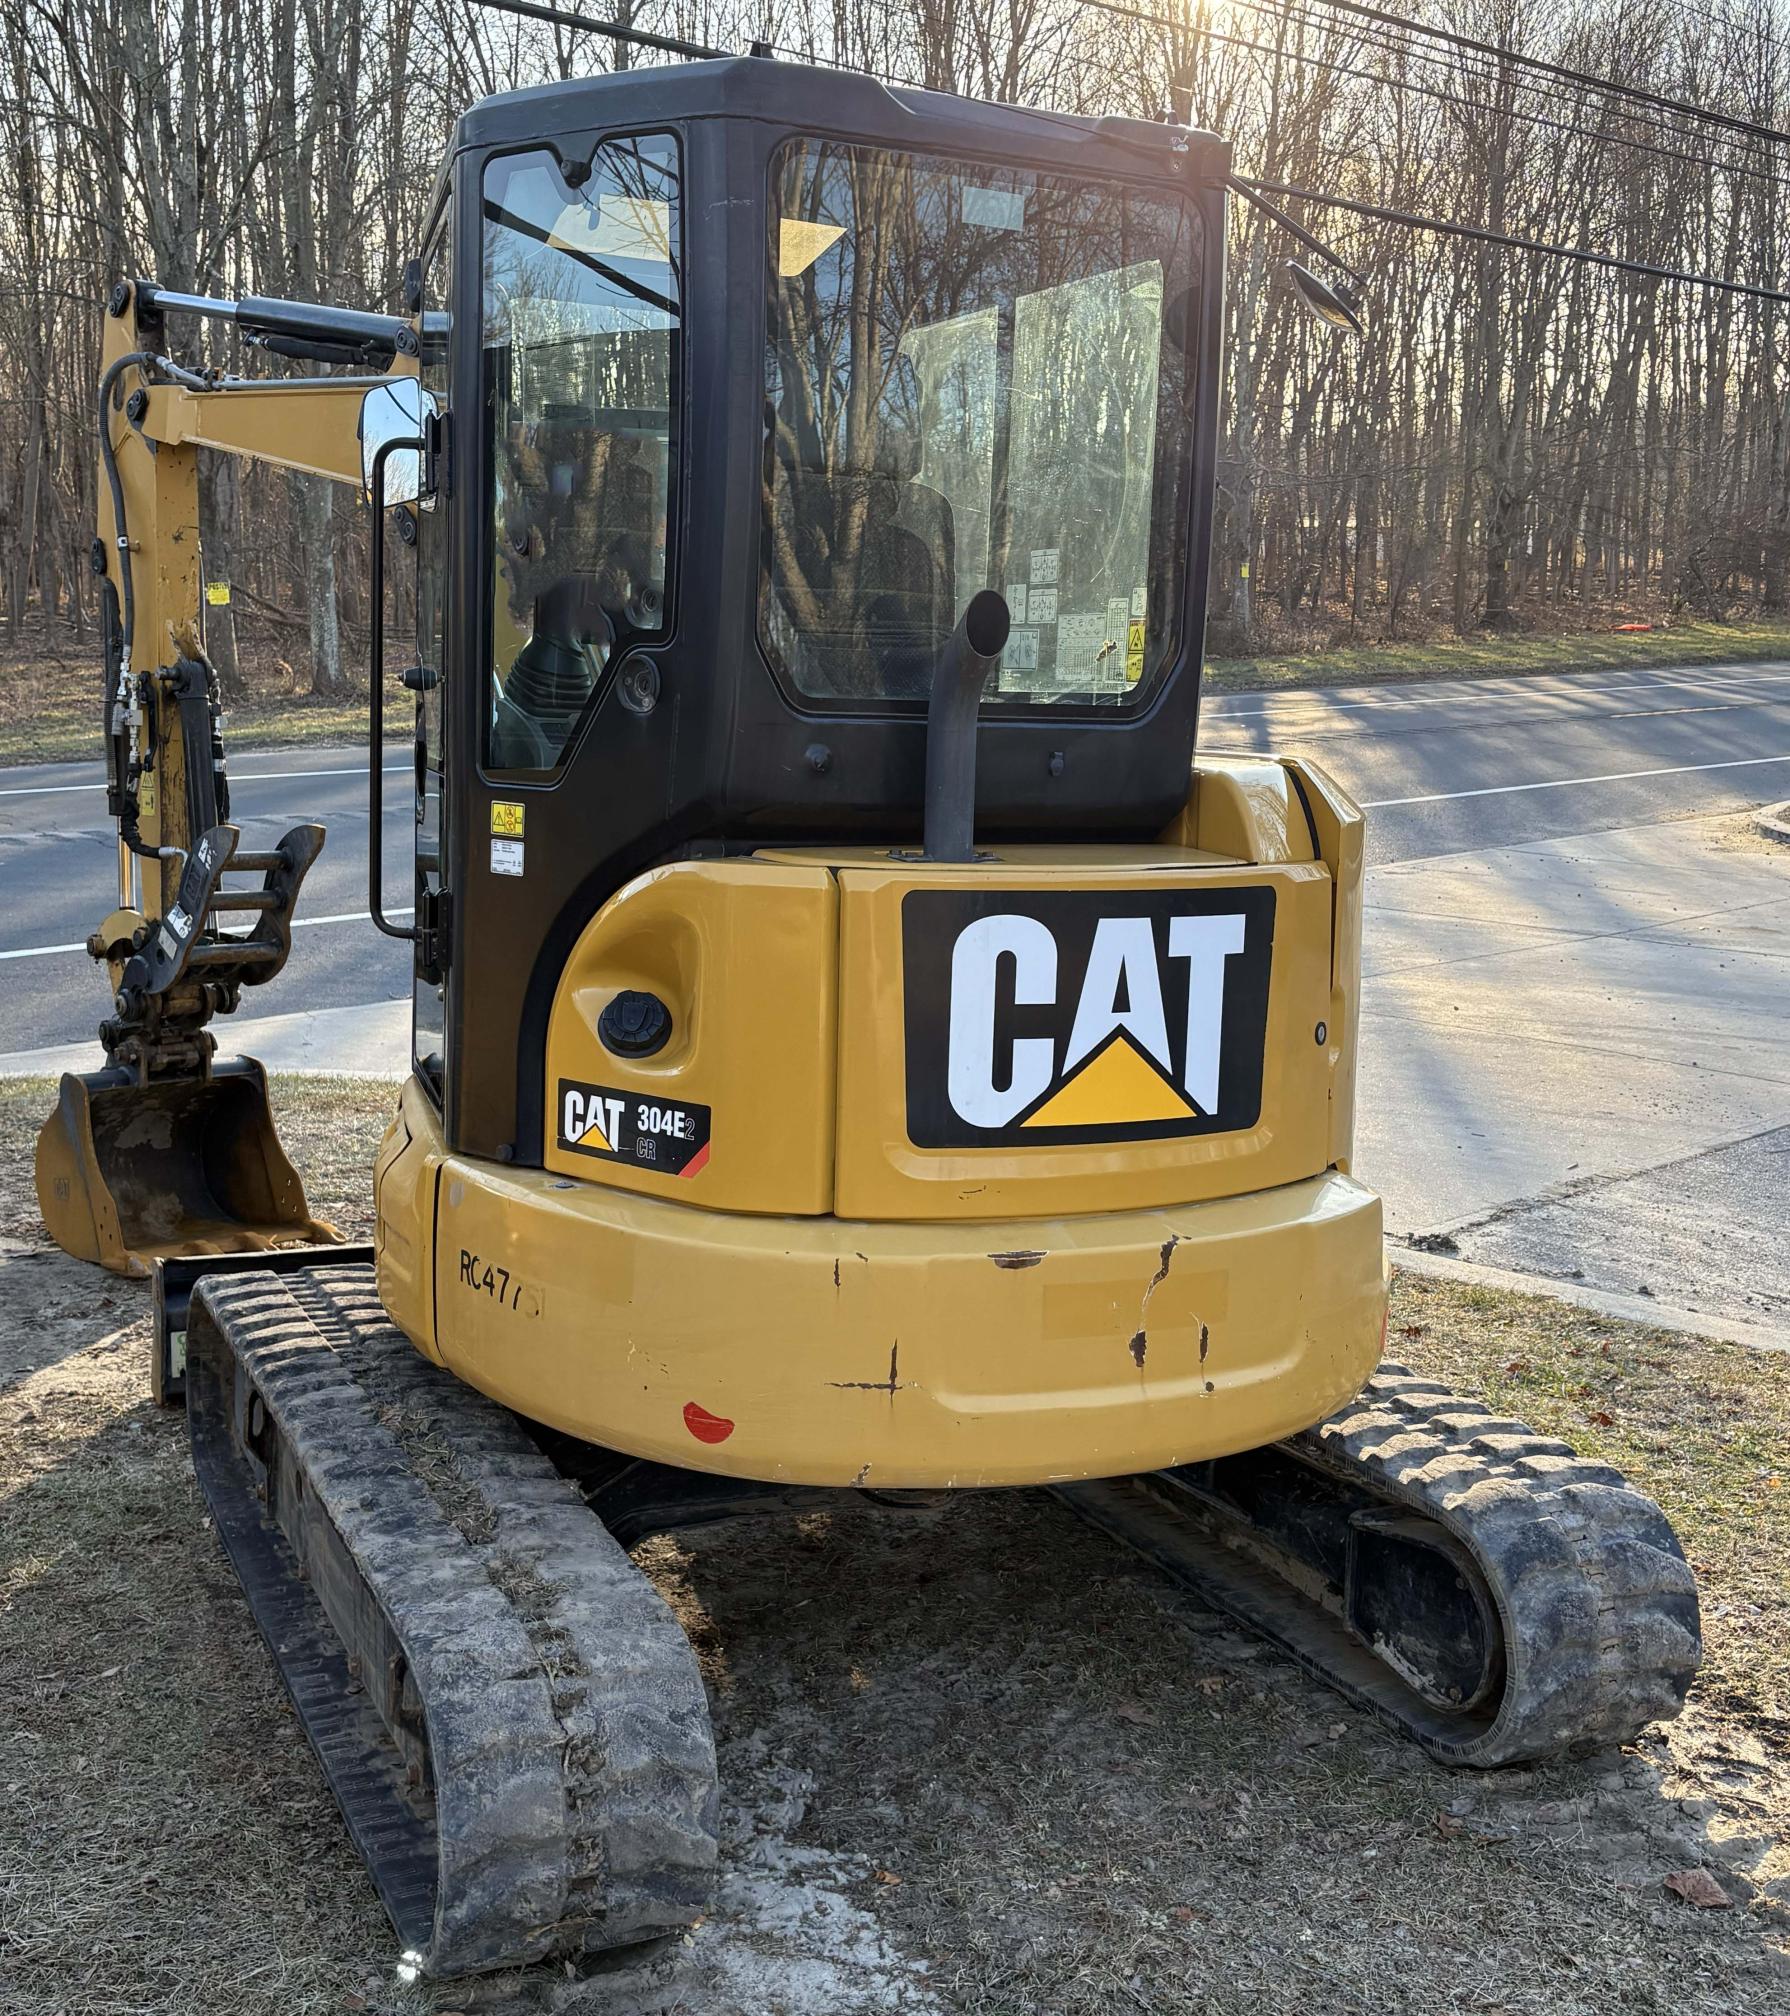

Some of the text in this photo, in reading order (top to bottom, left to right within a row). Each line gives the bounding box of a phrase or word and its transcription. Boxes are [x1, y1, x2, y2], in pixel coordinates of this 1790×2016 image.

[948, 914, 1246, 1128] CAT
[565, 1090, 625, 1152] CAT
[636, 1137, 656, 1160] CR
